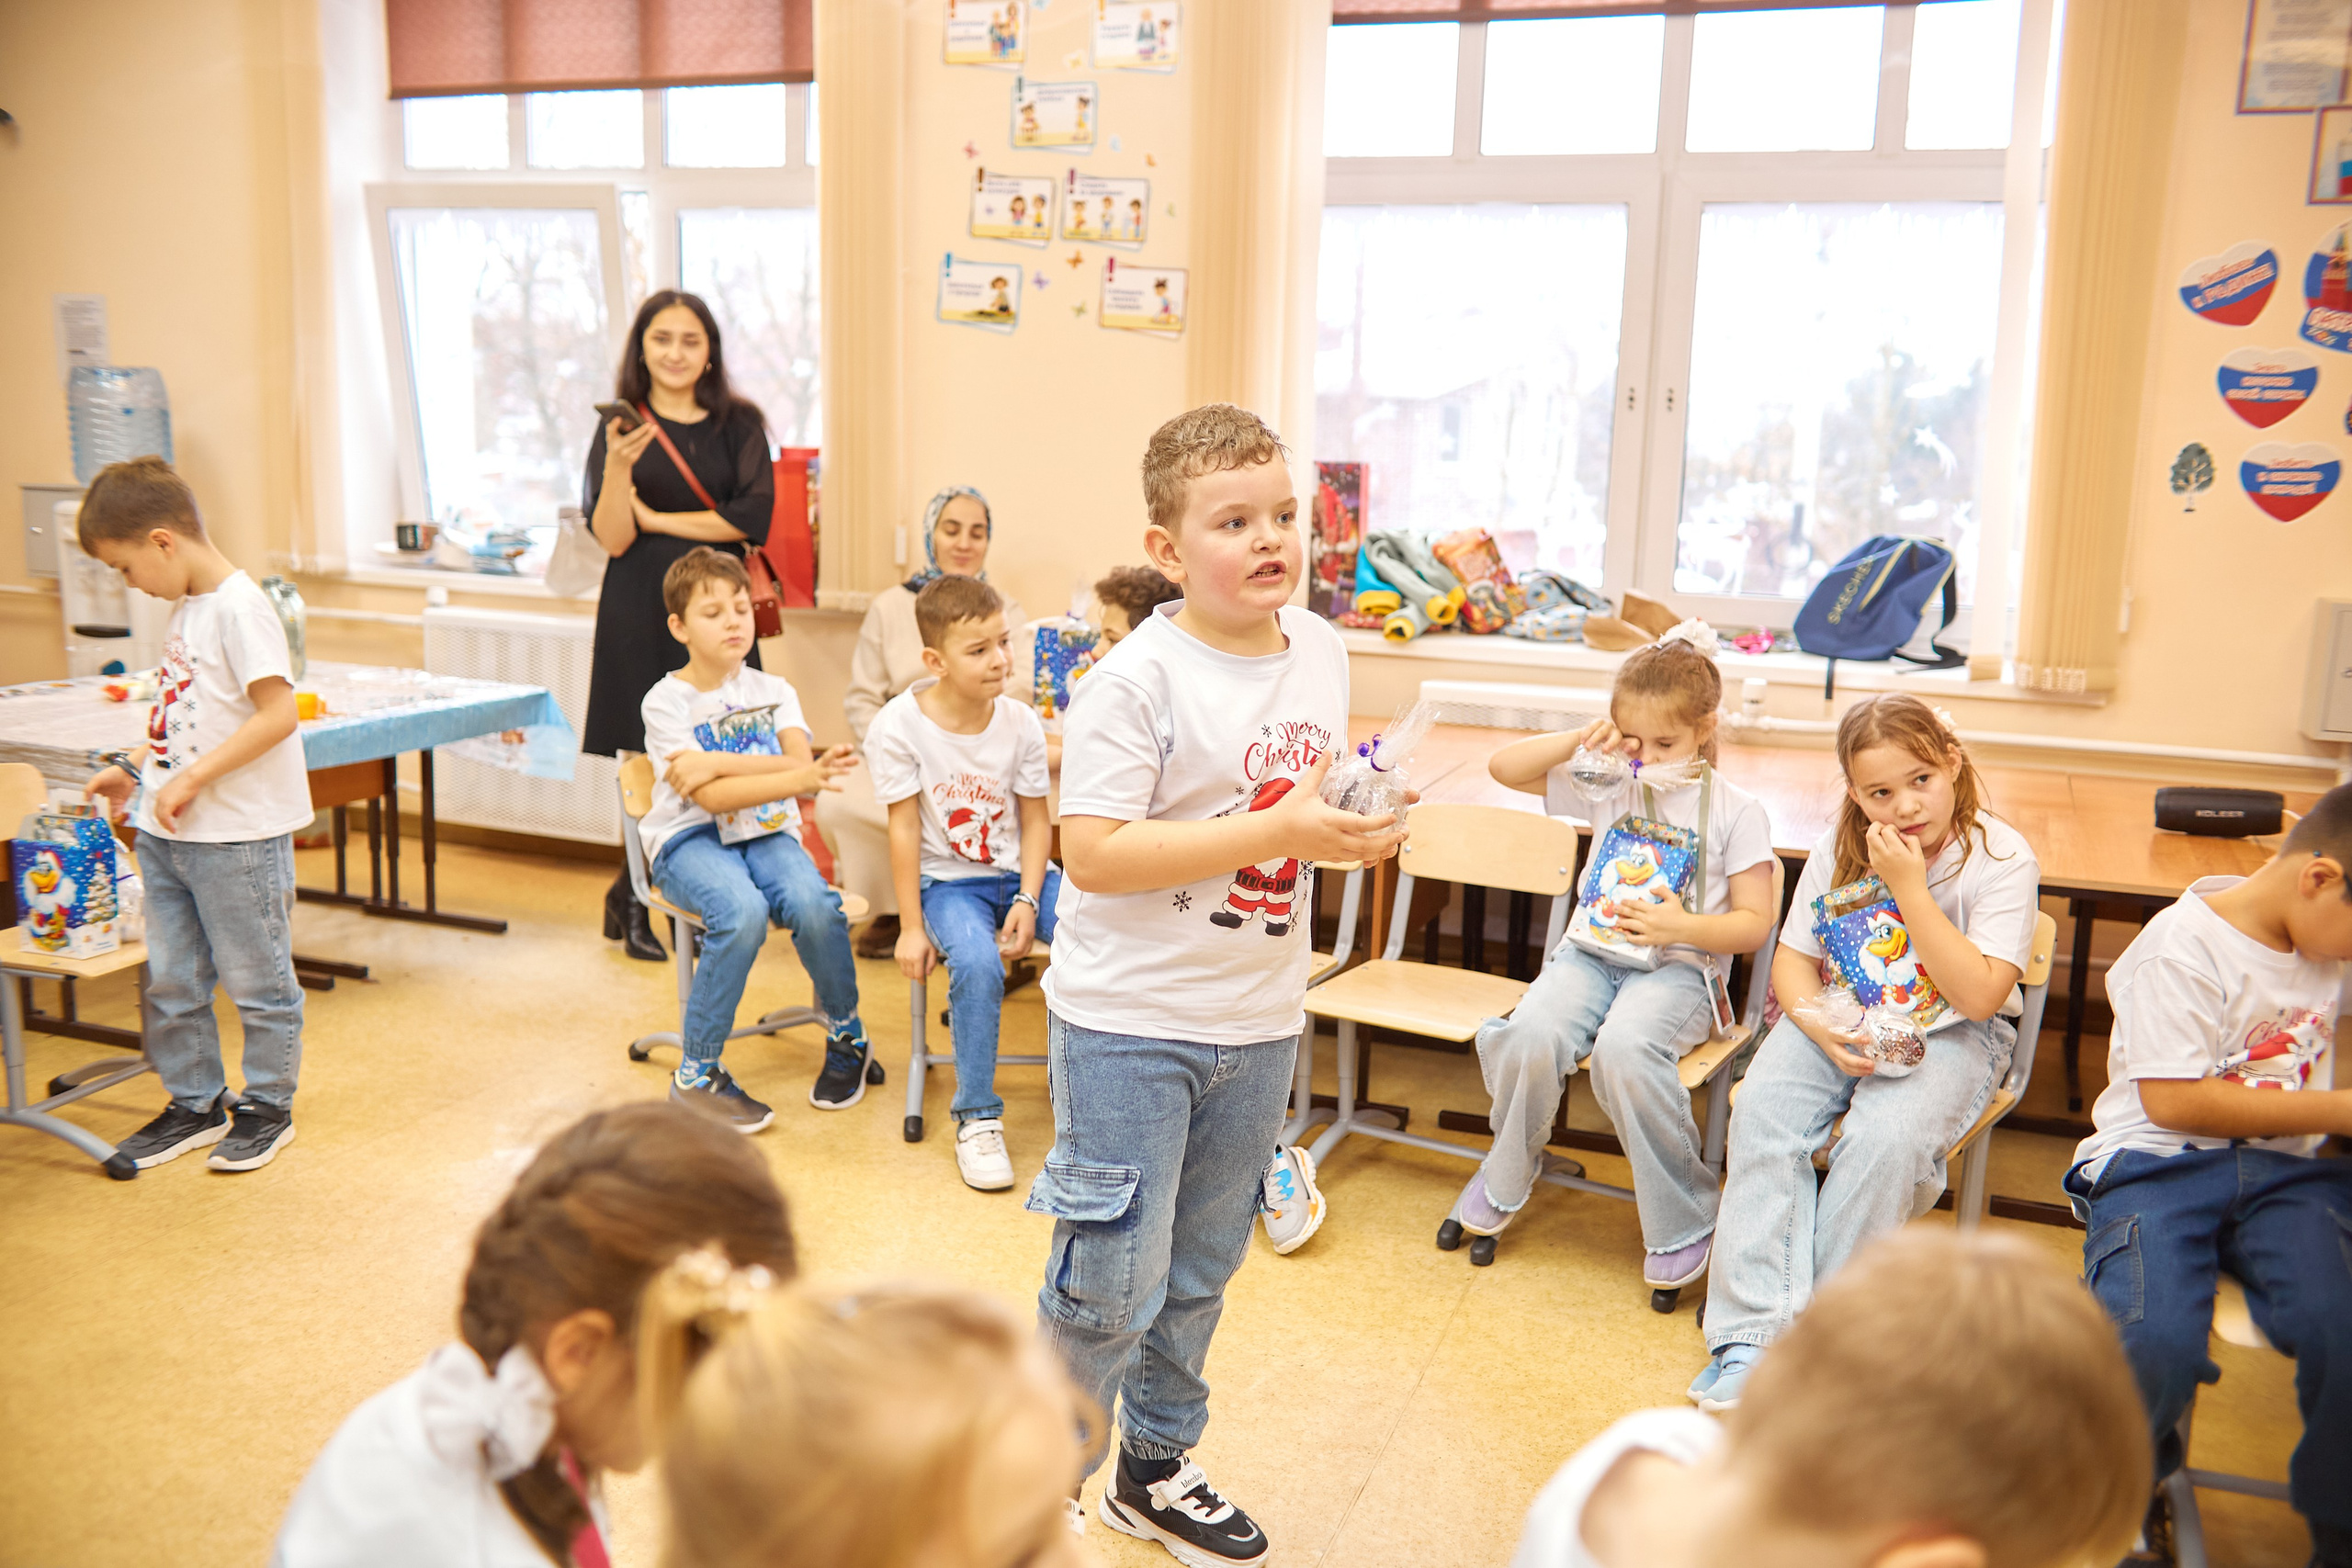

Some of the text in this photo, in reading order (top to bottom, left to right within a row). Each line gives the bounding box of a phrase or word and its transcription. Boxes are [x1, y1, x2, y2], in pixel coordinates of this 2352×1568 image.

[1276, 721, 1331, 750] Merry
[1244, 738, 1323, 782] Christ
[957, 773, 1000, 787] Merry
